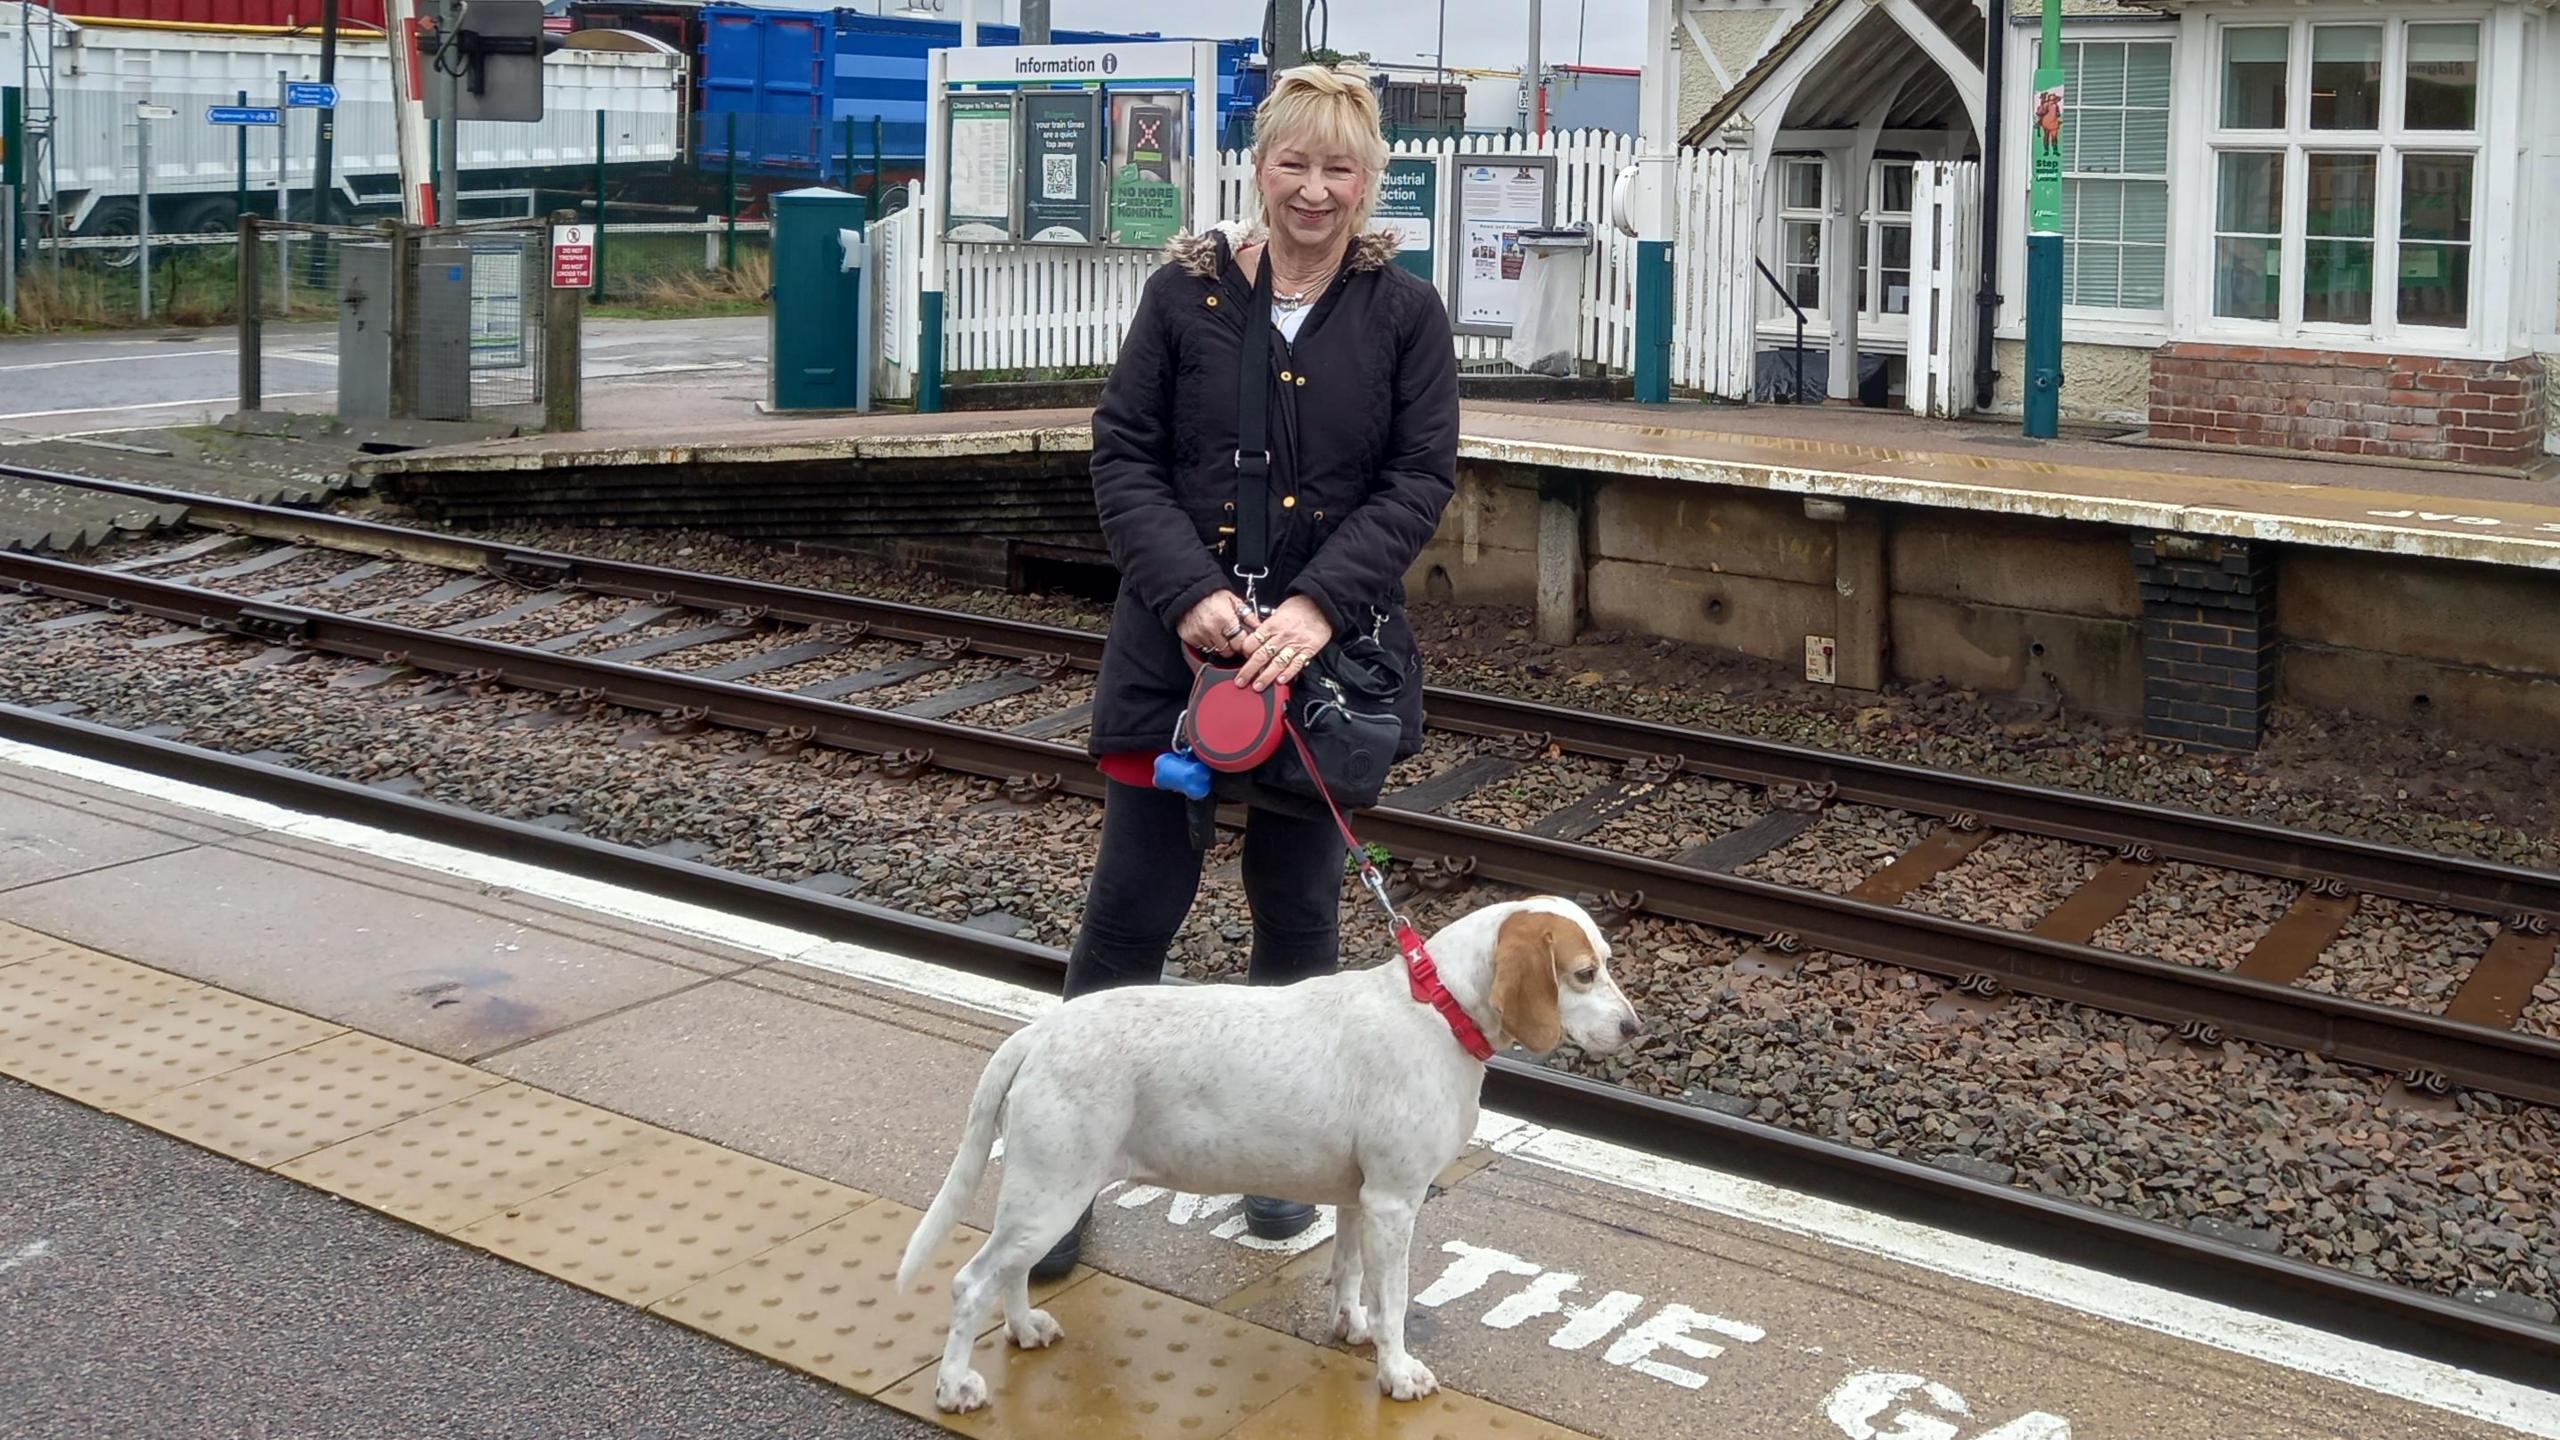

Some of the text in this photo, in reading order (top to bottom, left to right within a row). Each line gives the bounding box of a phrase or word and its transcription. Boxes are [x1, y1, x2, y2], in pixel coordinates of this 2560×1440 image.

[1015, 55, 1095, 73] Information
[1036, 120, 1085, 131] your train times
[1060, 130, 1078, 139] quick
[1046, 140, 1056, 149] tap
[2036, 160, 2058, 168] Step
[1380, 172, 1425, 186] dustrial
[1119, 187, 1173, 198] NO MORE
[1380, 187, 1416, 200] action
[1413, 1239, 1767, 1390] THE
